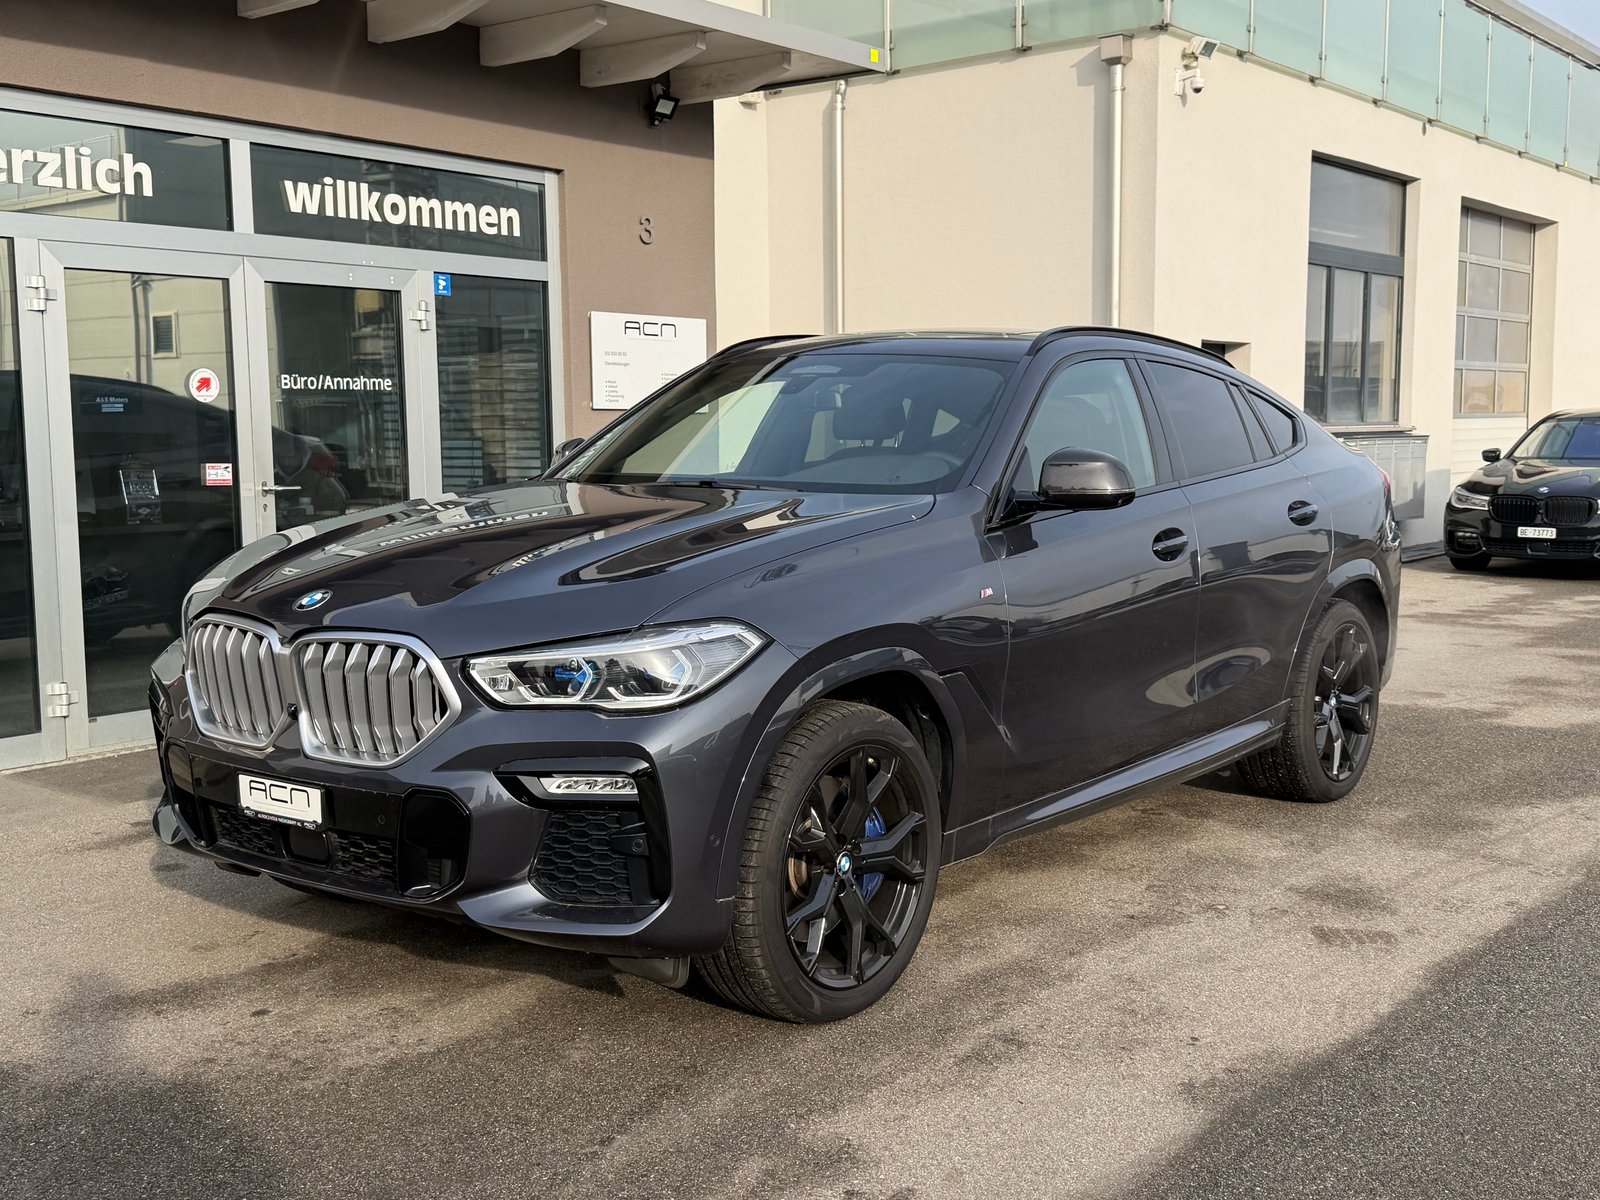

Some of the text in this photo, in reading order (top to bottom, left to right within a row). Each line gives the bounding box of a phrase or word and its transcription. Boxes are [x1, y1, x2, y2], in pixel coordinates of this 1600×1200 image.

[283, 176, 521, 237] willkommen
[639, 215, 654, 246] 3
[624, 320, 677, 338] ACN
[280, 373, 393, 391] Büro/Annahme
[1532, 529, 1553, 537] 73773
[249, 780, 310, 808] ACN
